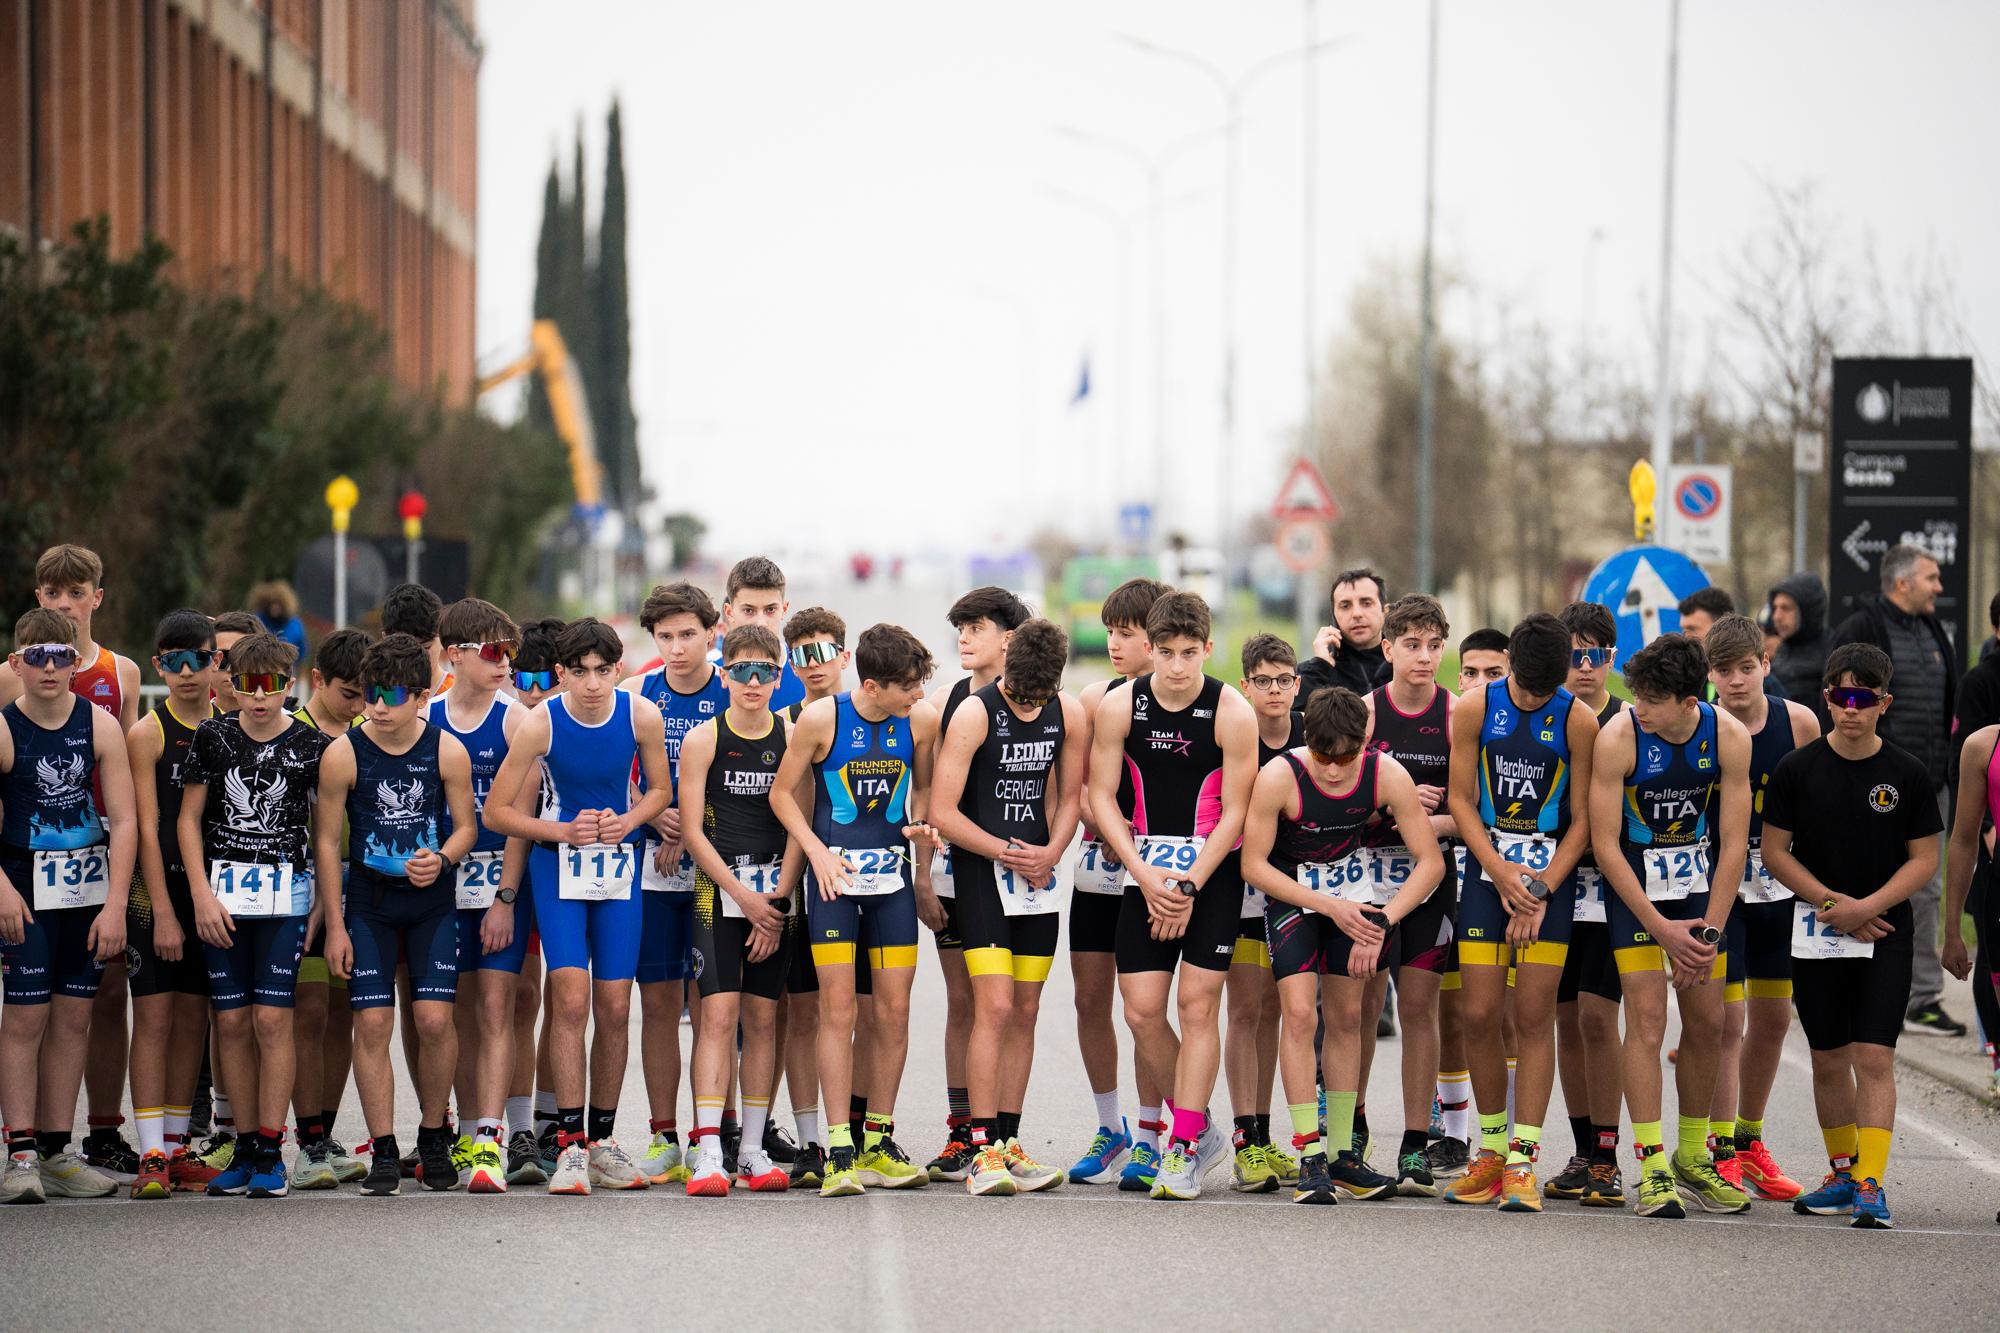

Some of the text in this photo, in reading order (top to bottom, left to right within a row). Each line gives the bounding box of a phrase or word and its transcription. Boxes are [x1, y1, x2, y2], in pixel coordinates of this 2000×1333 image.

[664, 717, 703, 730] iRENZ
[1151, 731, 1174, 739] TEAM
[67, 738, 87, 746] DAMA
[1000, 740, 1055, 764] LEONE
[1395, 752, 1447, 762] MINERVA
[283, 760, 305, 769] DAMA
[849, 760, 901, 769] THUNDER
[1006, 762, 1047, 772] TRIATHLON
[1495, 755, 1545, 779] Marchiorri
[849, 767, 900, 776] TRIATHLON
[857, 779, 890, 796] ITA
[995, 778, 1044, 801] CERVELLI
[1497, 776, 1538, 799] ITA
[1878, 791, 1889, 806] L
[1004, 803, 1035, 822] ITA
[1653, 800, 1699, 820] ITA
[379, 816, 425, 825] TRIATHLON
[1496, 816, 1537, 825] THUNDER
[1496, 822, 1537, 830] TRIATHLON
[217, 830, 282, 844] NEW ENERGY
[226, 840, 269, 850] PERUGIA
[1139, 844, 1197, 871] 129
[568, 852, 629, 879] 117
[1369, 858, 1411, 883] 15
[41, 856, 103, 887] 132
[1305, 857, 1364, 890] 136
[219, 867, 282, 894] 141
[22, 967, 45, 975] DAMA
[272, 966, 292, 975] DAMA
[437, 962, 456, 971] DAMA
[355, 969, 378, 977] DAMA
[217, 992, 245, 1000] ENERGY
